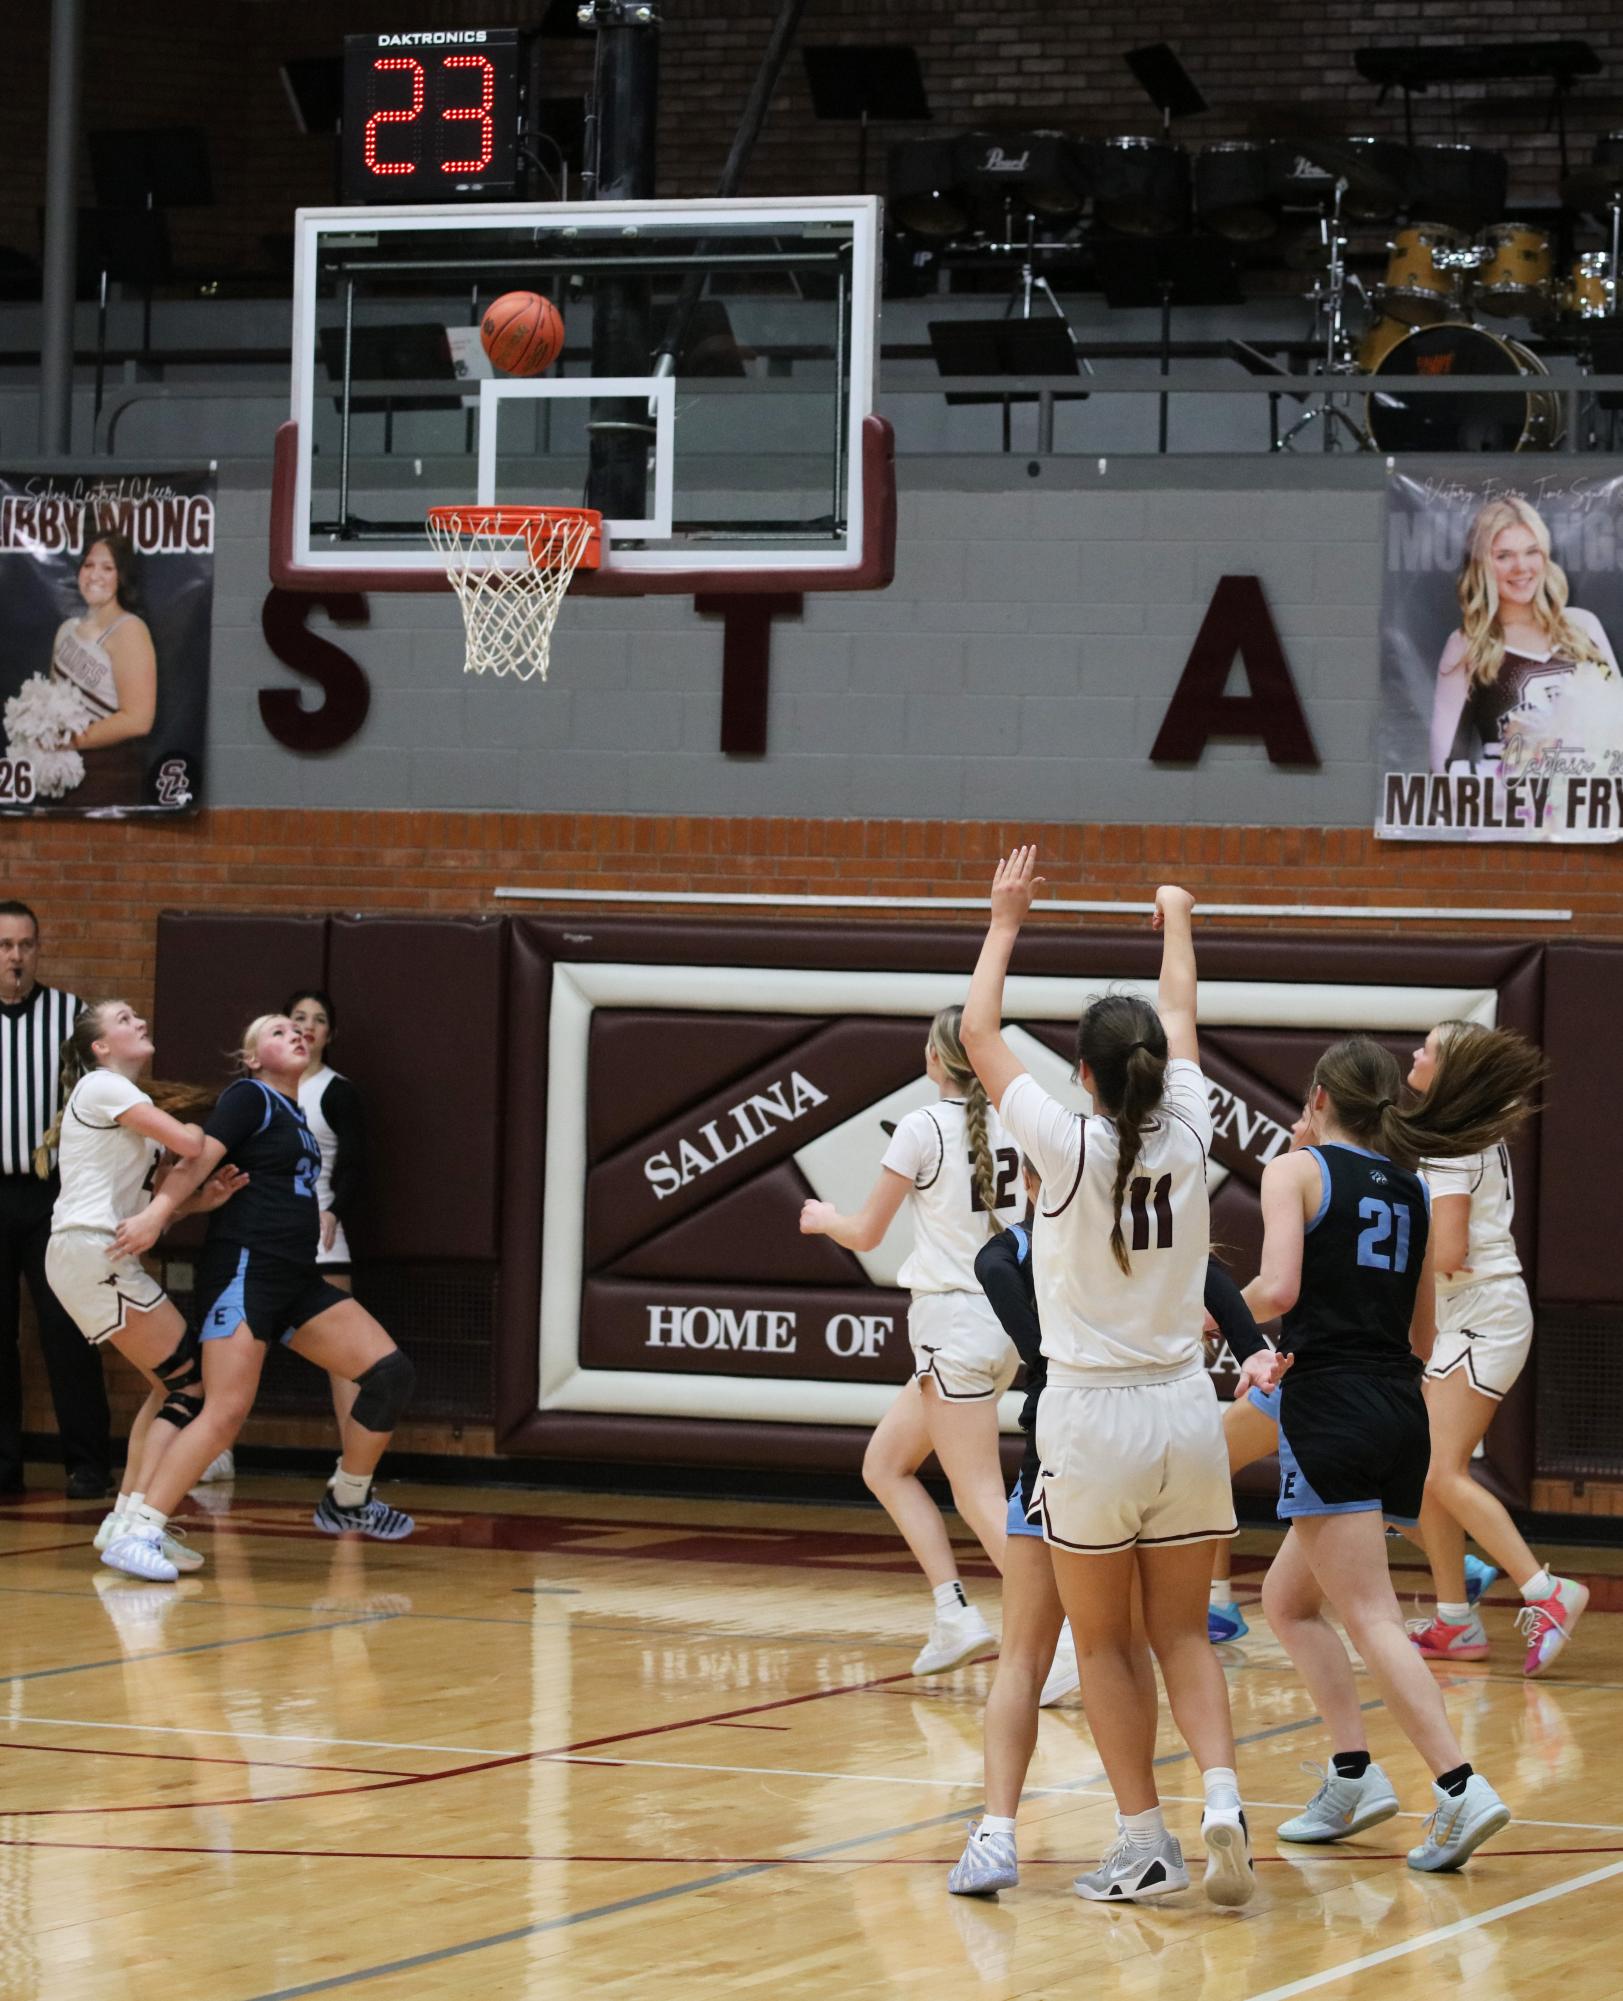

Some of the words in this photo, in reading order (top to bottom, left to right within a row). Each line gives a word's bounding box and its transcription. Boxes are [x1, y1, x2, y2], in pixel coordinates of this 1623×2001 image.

[378, 31, 487, 46] DAKTRONICS
[364, 55, 494, 175] 23
[0, 496, 84, 554] IBBY
[72, 477, 125, 512] Central
[128, 475, 176, 508] Cheer
[1502, 733, 1596, 798] Captain
[1384, 772, 1550, 829] MARLEY
[643, 1070, 829, 1200] SALINA
[969, 1147, 1019, 1213] 22
[1129, 1173, 1173, 1251] 11
[1356, 1196, 1411, 1273] 21
[644, 1305, 798, 1354] HOME
[825, 1314, 894, 1358] OF
